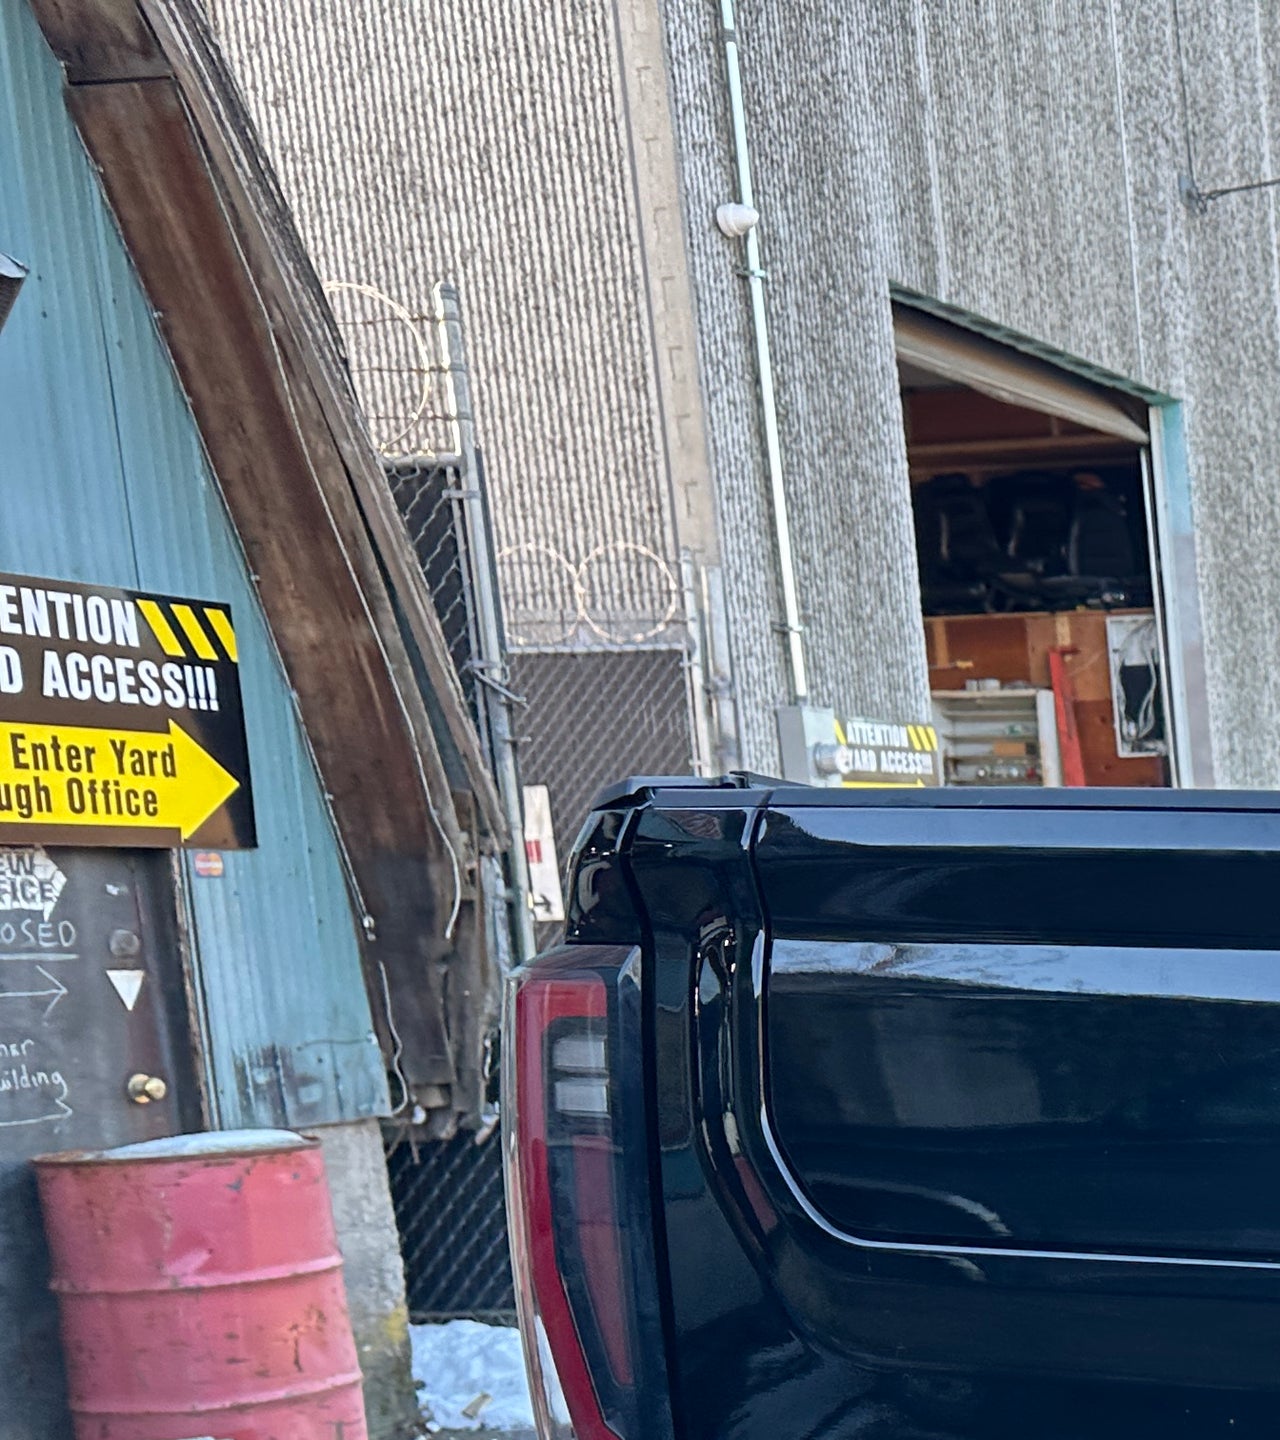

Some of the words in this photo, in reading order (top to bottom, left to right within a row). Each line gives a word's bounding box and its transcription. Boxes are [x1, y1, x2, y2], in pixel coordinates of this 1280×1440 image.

[43, 650, 219, 712] ACCESS!!!
[10, 732, 97, 774] Enter
[109, 738, 177, 778] Yard
[846, 721, 909, 747] ATTENTION
[66, 777, 158, 817] Office
